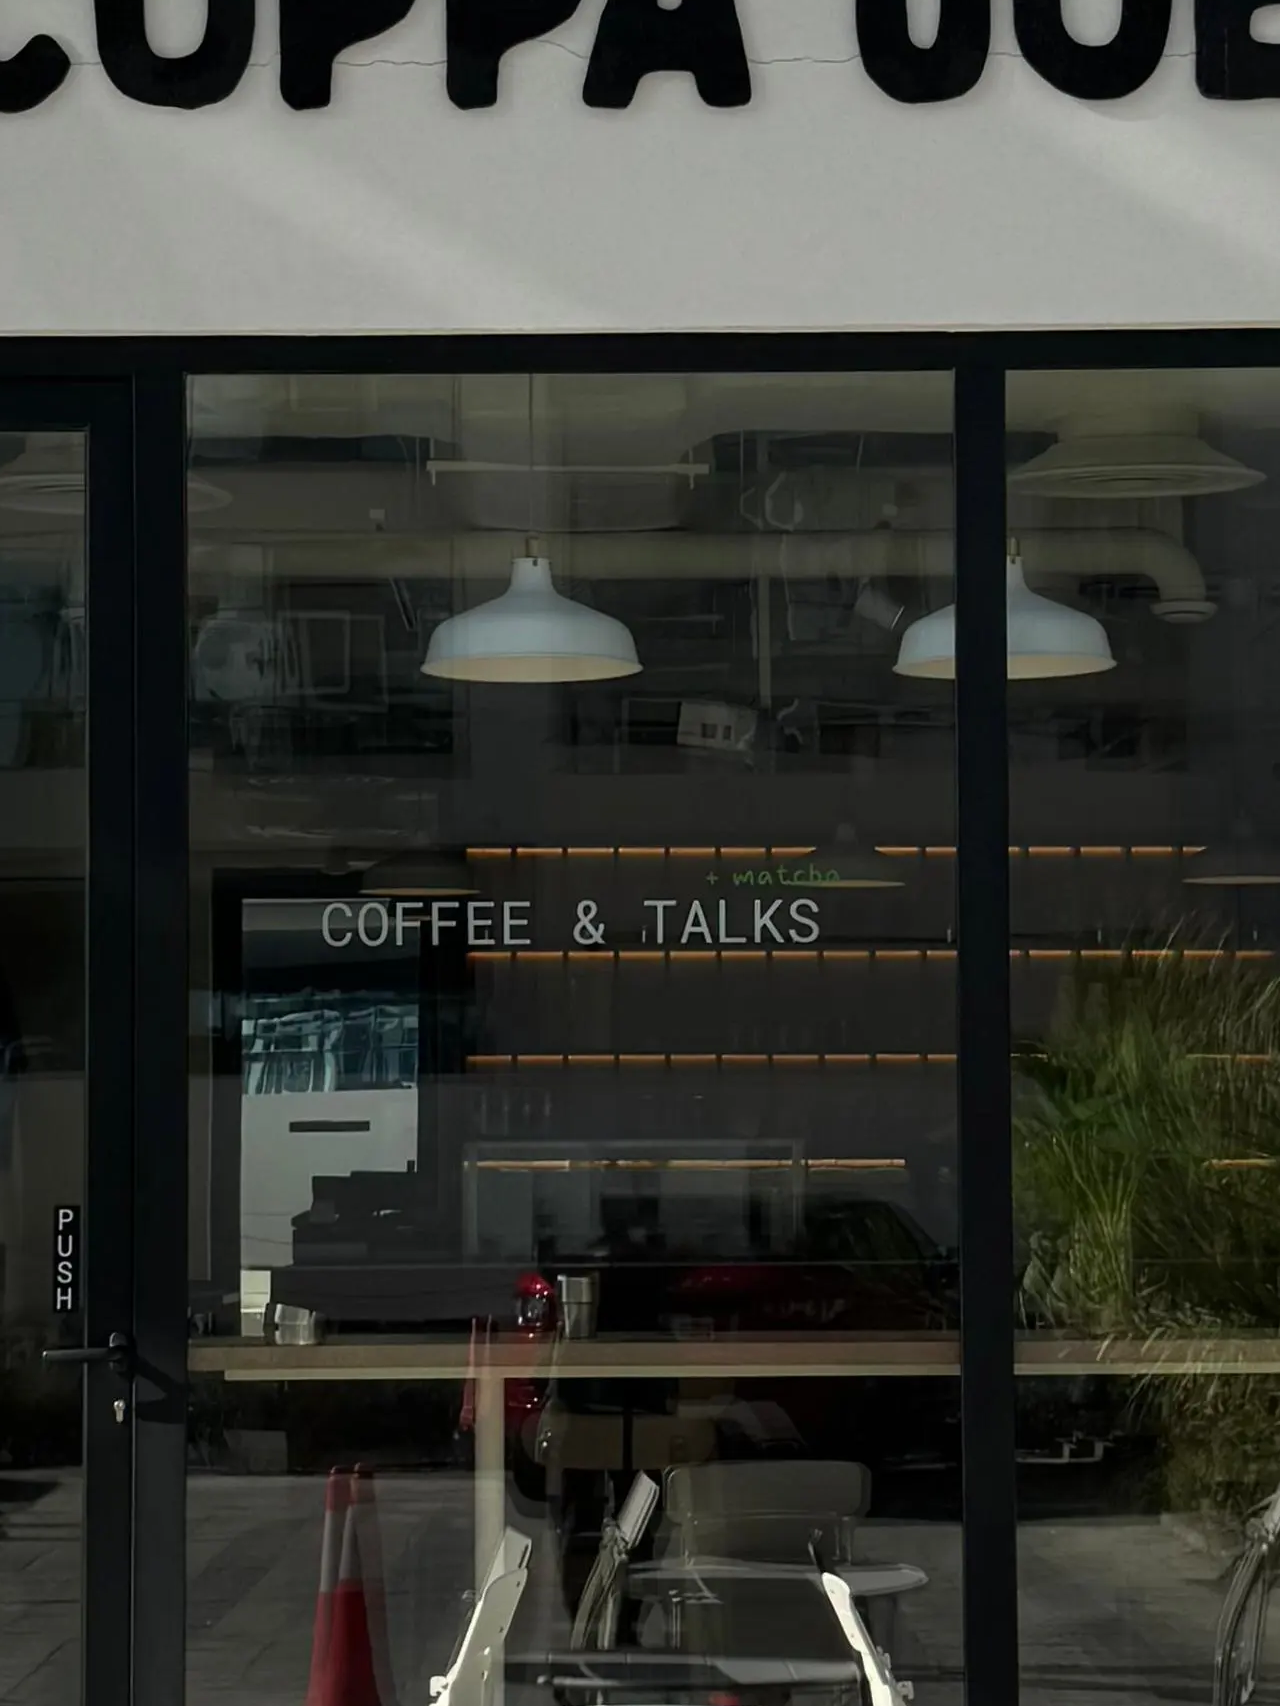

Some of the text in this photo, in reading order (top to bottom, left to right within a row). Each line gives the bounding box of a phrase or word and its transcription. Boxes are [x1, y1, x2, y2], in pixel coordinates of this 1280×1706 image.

[321, 898, 821, 947] COFFEE & TALKS
[55, 1209, 74, 1309] PUSH
